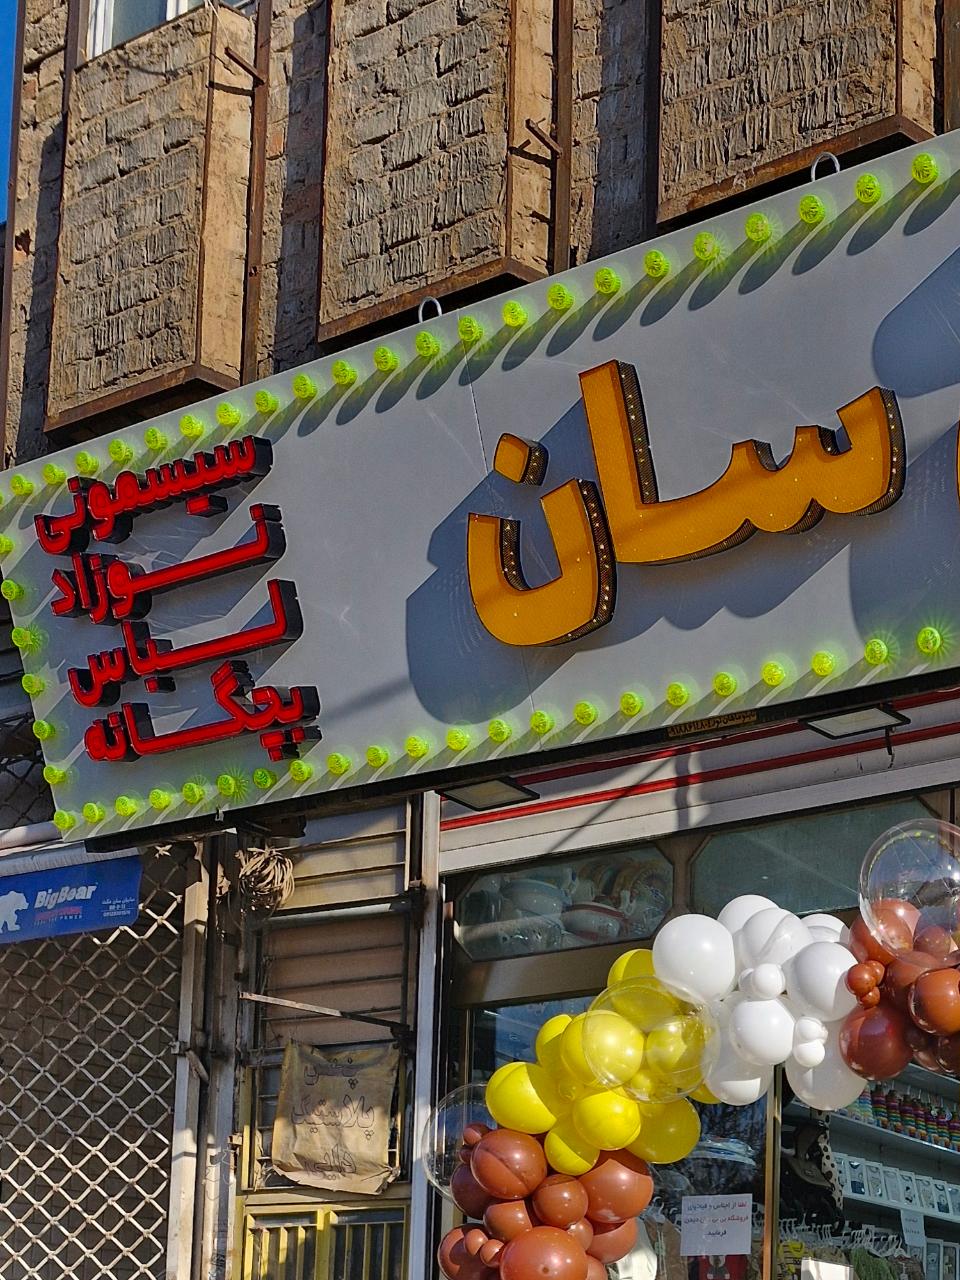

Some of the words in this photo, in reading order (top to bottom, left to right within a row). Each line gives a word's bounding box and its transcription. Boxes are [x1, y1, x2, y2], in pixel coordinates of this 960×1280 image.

[35, 435, 273, 556] سیسمونی
[467, 358, 907, 648] سان
[50, 503, 288, 626] نوزاد
[67, 578, 304, 708] لباس
[84, 660, 323, 763] بچگانه
[34, 885, 97, 909] BigBear
